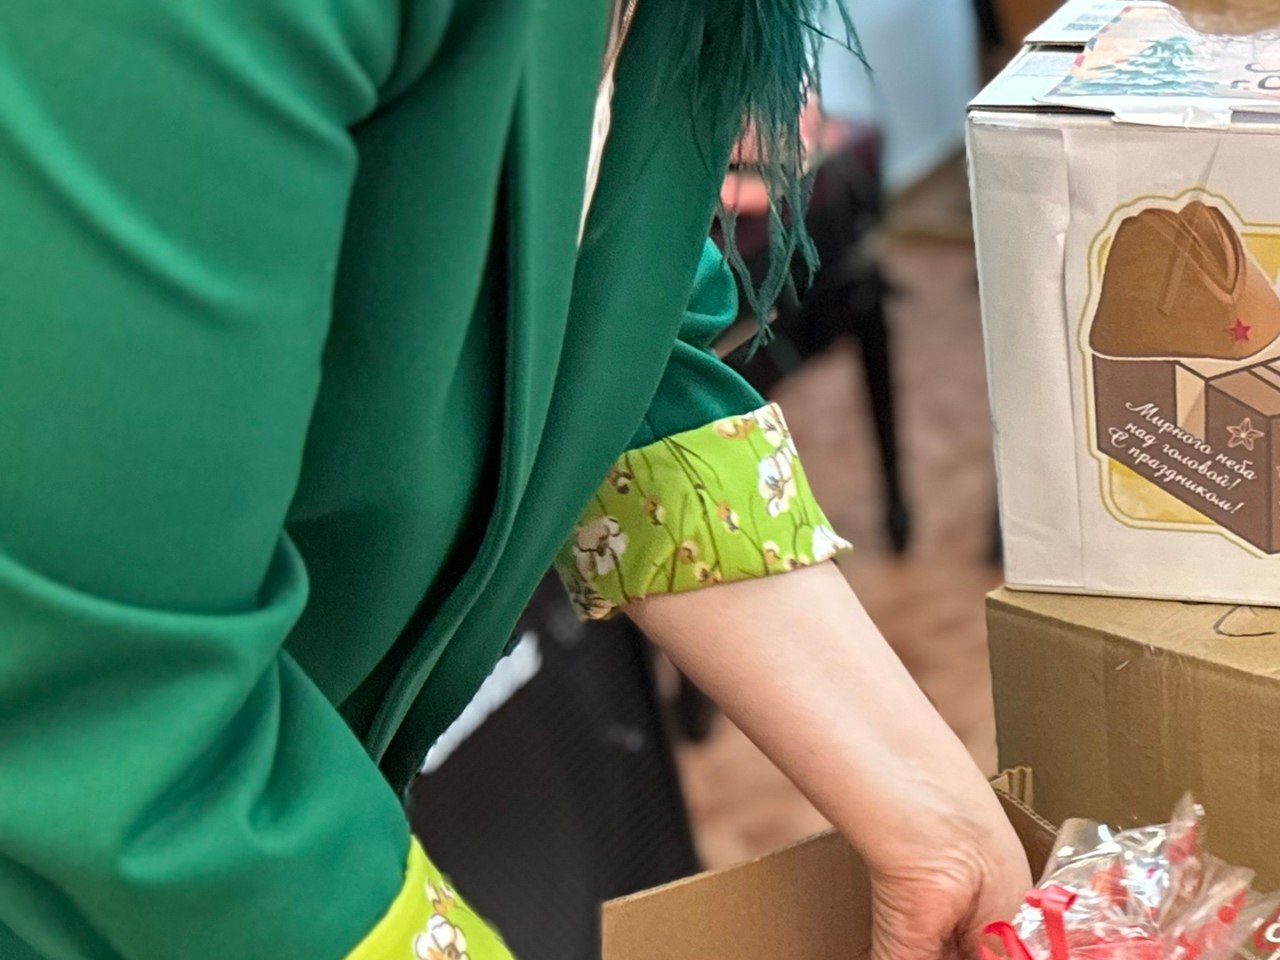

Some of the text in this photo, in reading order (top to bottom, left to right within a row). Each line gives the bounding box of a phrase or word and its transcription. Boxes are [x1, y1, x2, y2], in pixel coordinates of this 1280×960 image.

[1108, 426, 1245, 514] С праздником!
[1124, 422, 1242, 491] над головой!
[1125, 402, 1257, 480] Мирного неба
